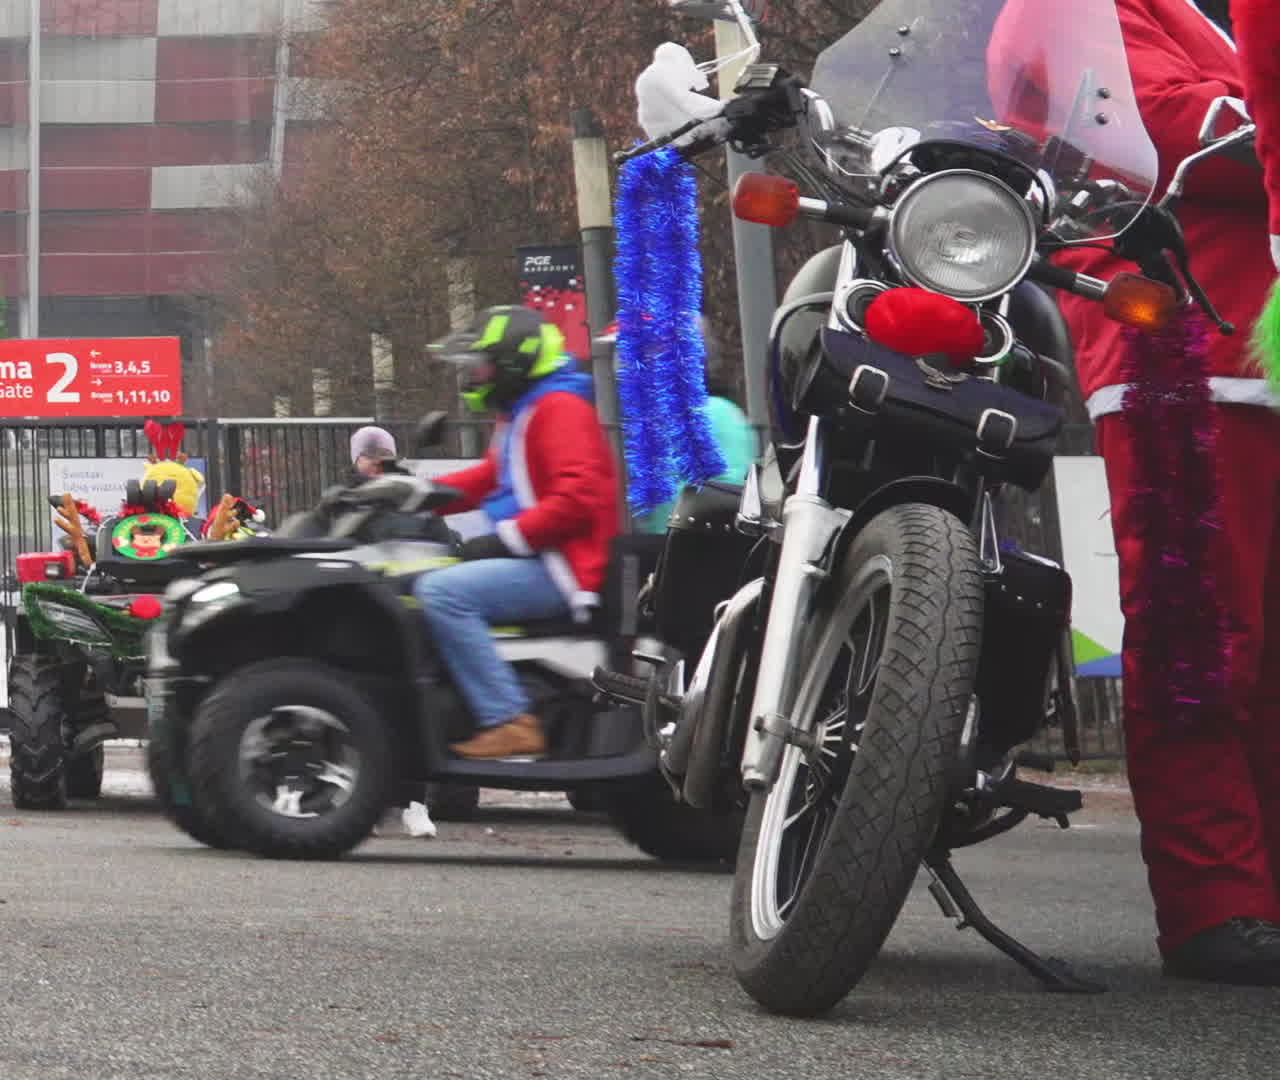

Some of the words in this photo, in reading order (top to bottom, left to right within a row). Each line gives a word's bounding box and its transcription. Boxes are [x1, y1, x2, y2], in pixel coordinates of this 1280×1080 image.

[524, 255, 552, 266] PGE
[114, 360, 151, 376] 3,4,5
[45, 352, 81, 403] 2
[115, 389, 171, 405] 1,11,10
